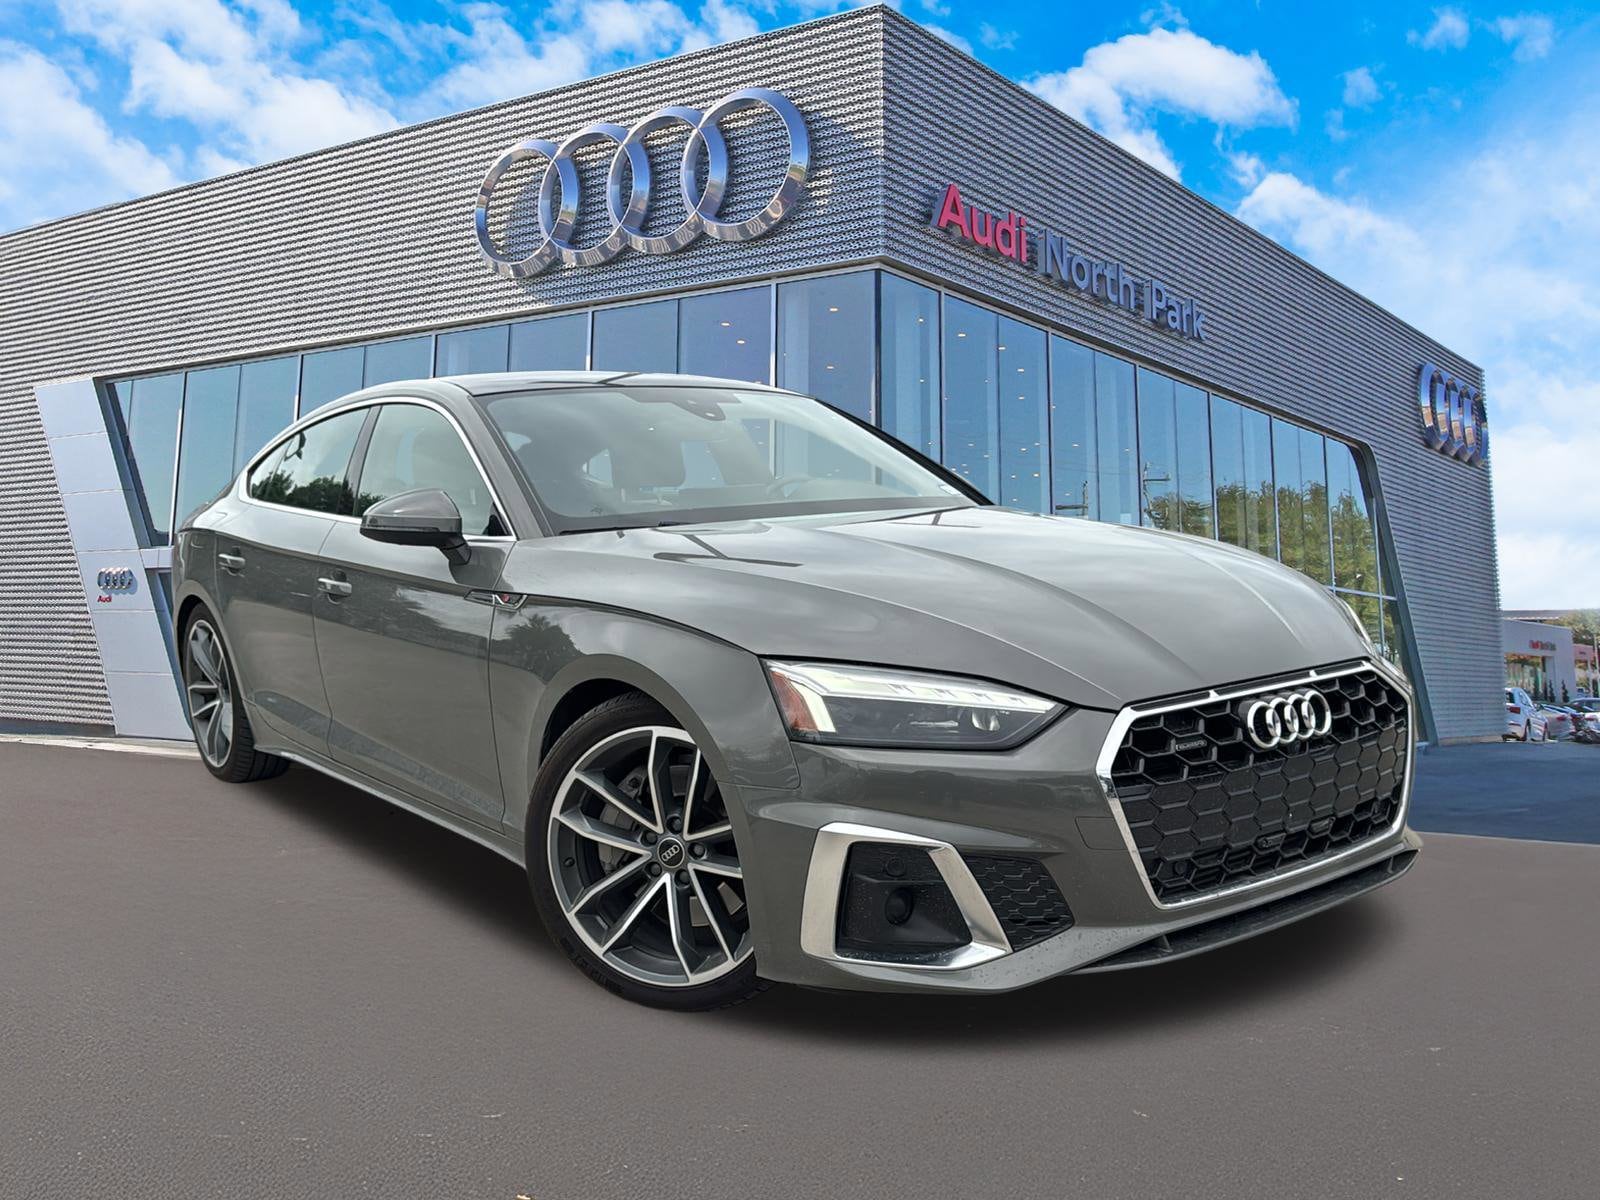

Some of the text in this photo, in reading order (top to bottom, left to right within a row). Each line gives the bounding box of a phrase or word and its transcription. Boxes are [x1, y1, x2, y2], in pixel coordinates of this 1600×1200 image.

[933, 183, 1208, 341] Audi North Park
